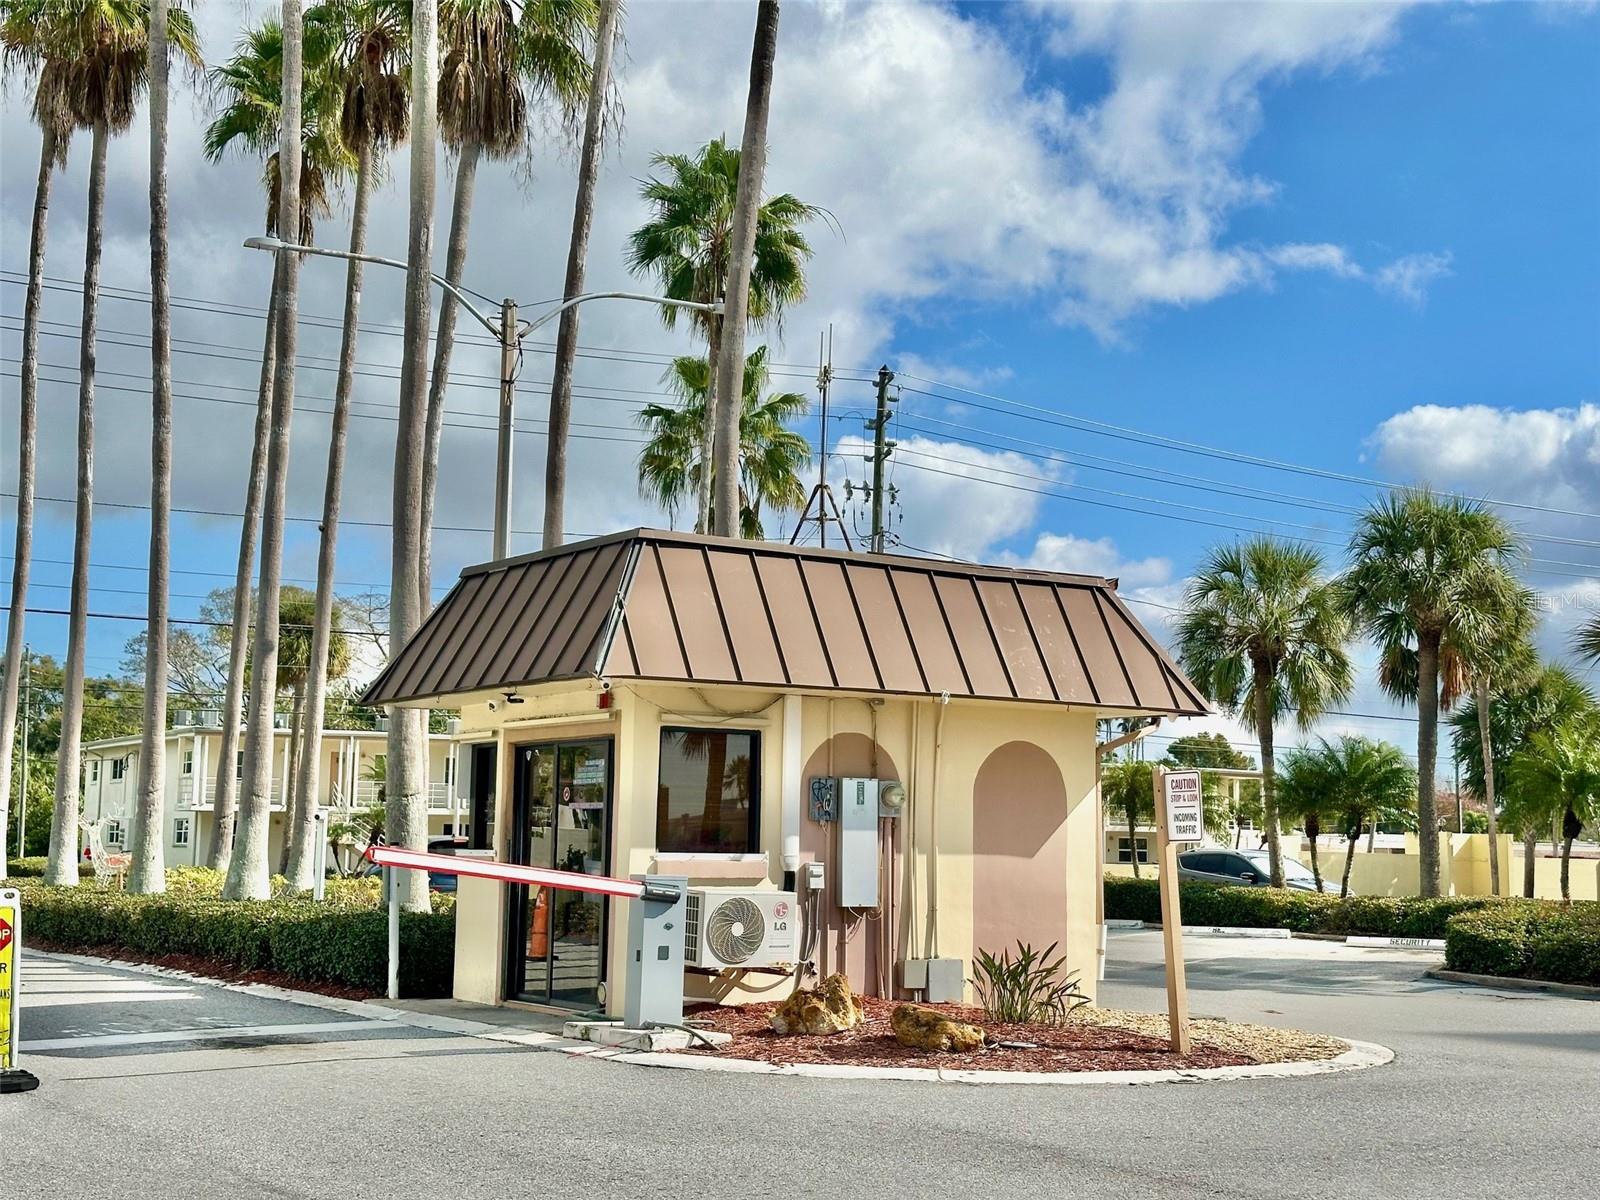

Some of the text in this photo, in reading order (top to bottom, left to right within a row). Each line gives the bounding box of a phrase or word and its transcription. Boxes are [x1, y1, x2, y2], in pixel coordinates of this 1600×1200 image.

[1171, 778, 1197, 790] CAUTION
[1171, 793, 1199, 803] STOP & LOOK
[1174, 812, 1198, 823] INCOMING
[1176, 824, 1197, 835] TRAFFIC
[774, 921, 787, 931] LG
[1389, 938, 1431, 947] SECURITY
